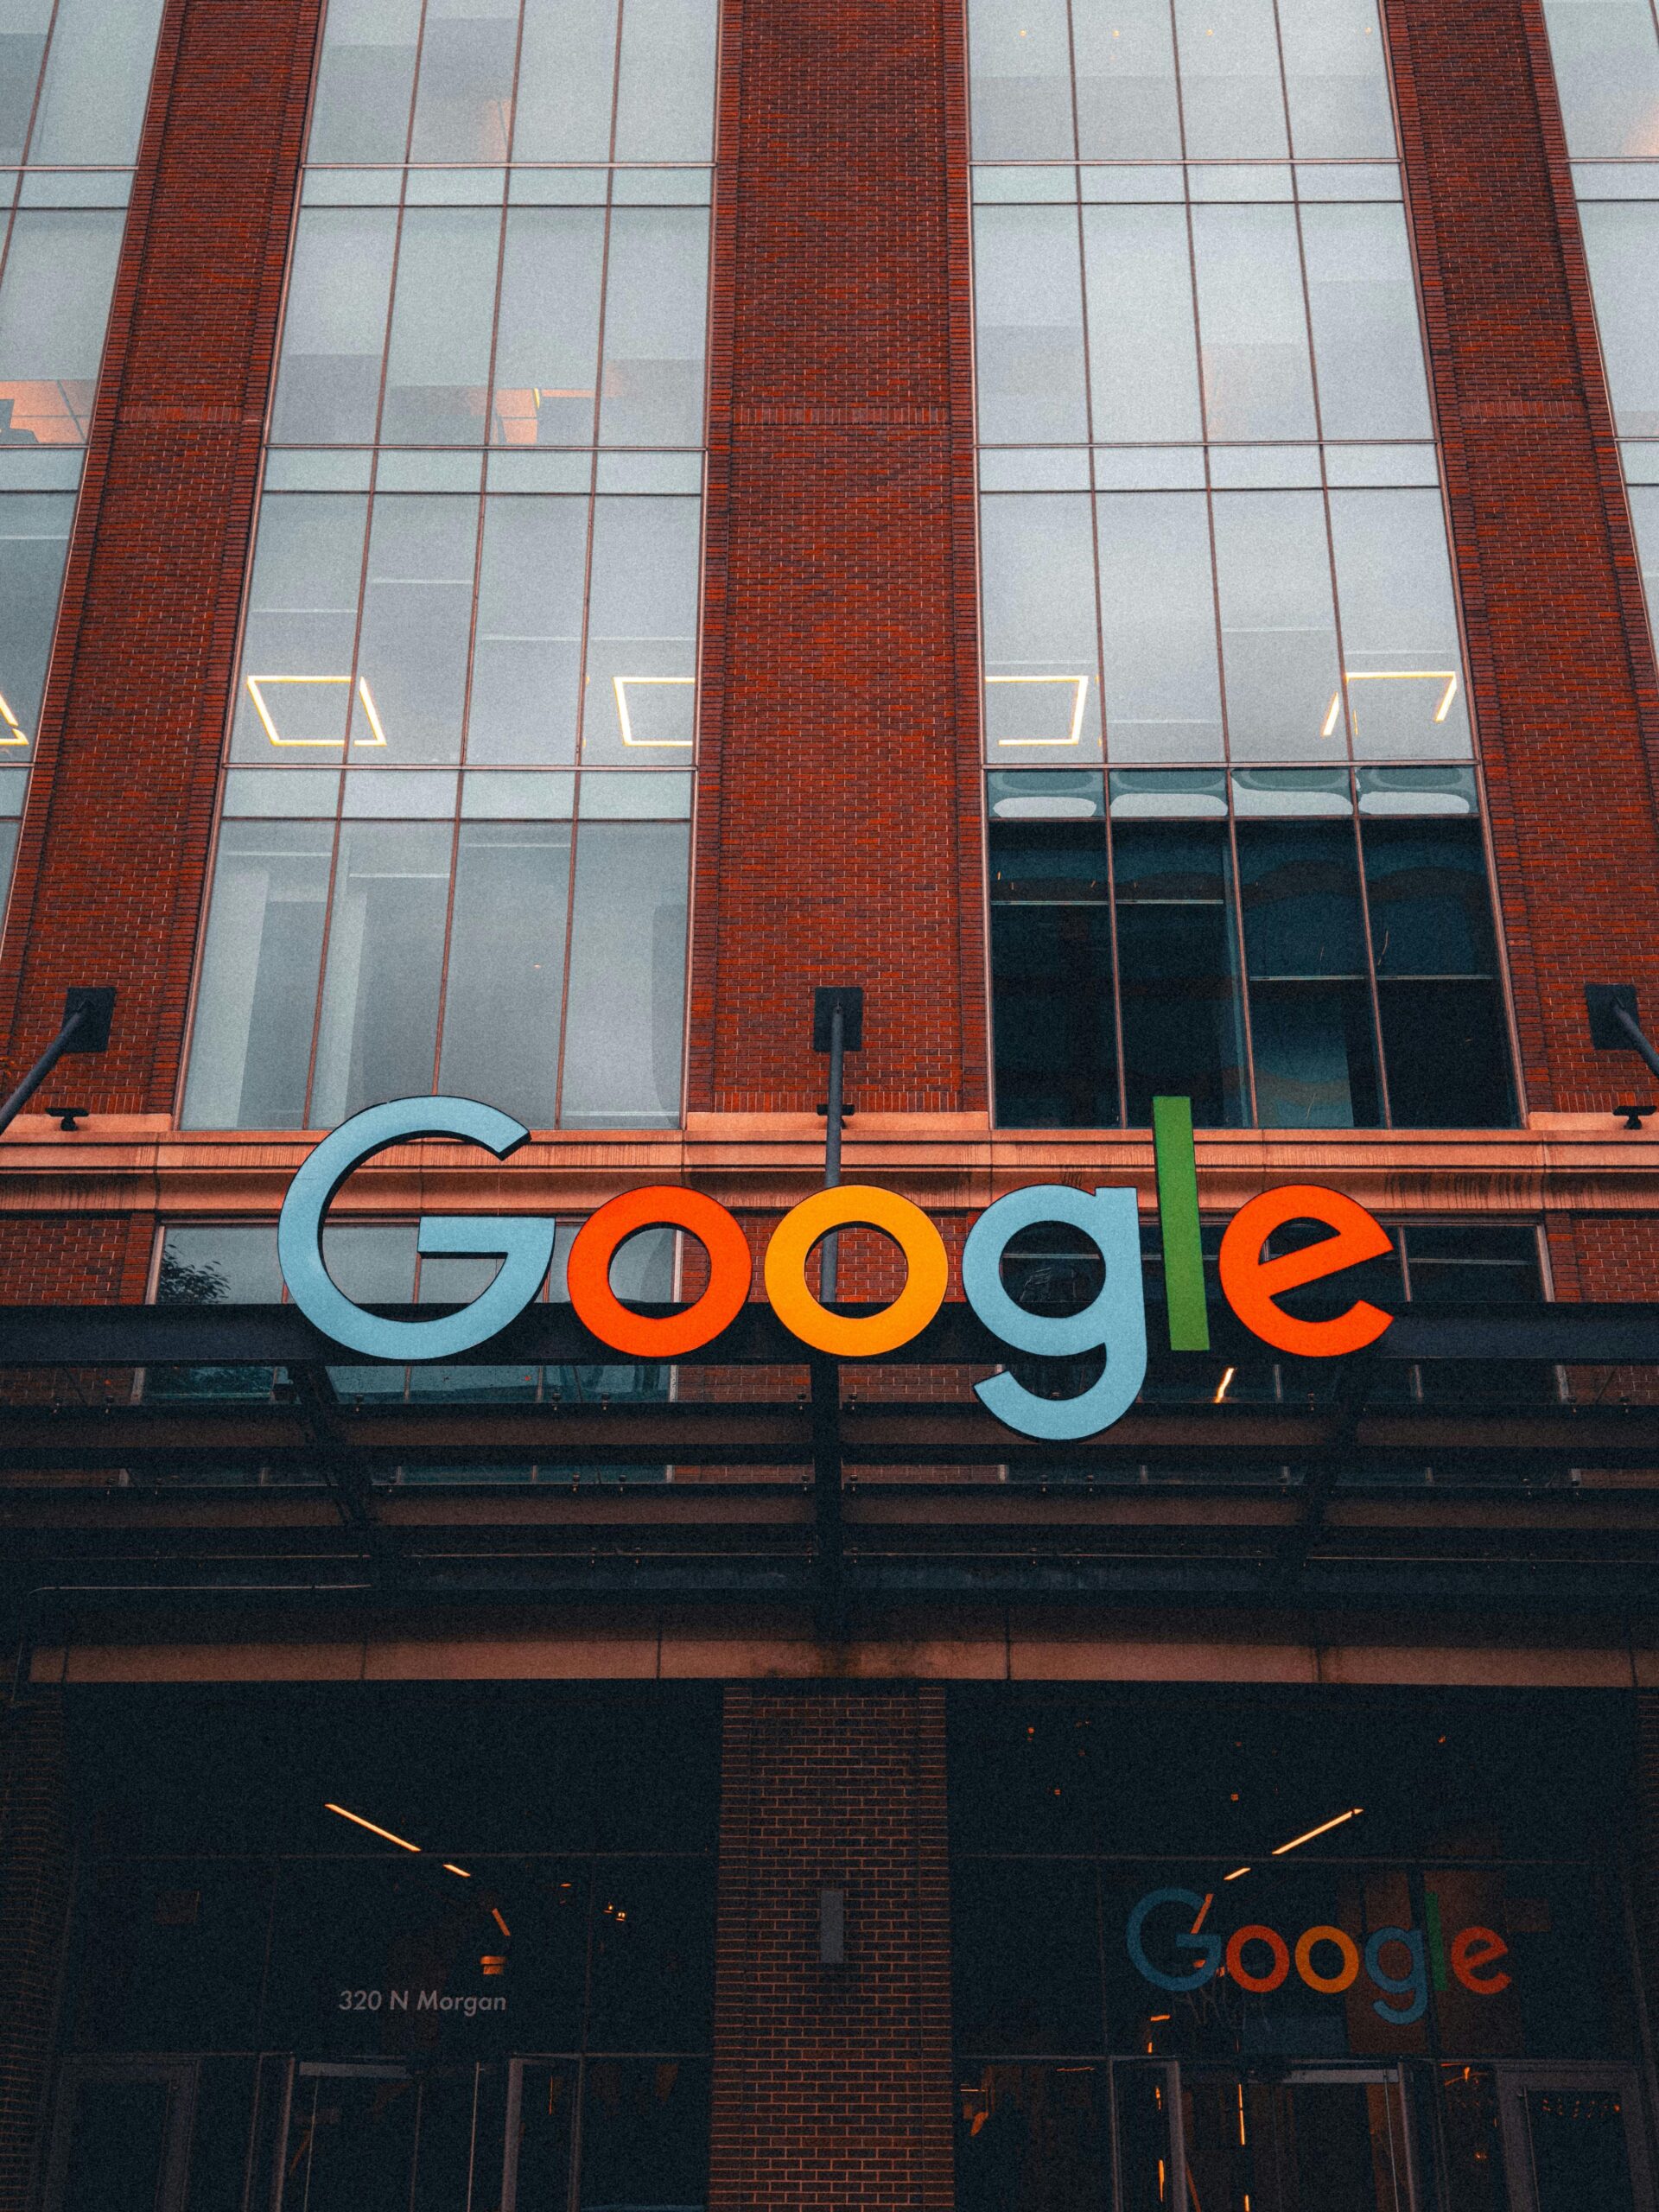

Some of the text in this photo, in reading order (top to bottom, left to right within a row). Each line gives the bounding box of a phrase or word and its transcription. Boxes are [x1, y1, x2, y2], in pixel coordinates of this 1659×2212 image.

[276, 1095, 1395, 1441] Google
[338, 1989, 507, 2018] 320 N Morgan
[1125, 1886, 1512, 2025] Google
